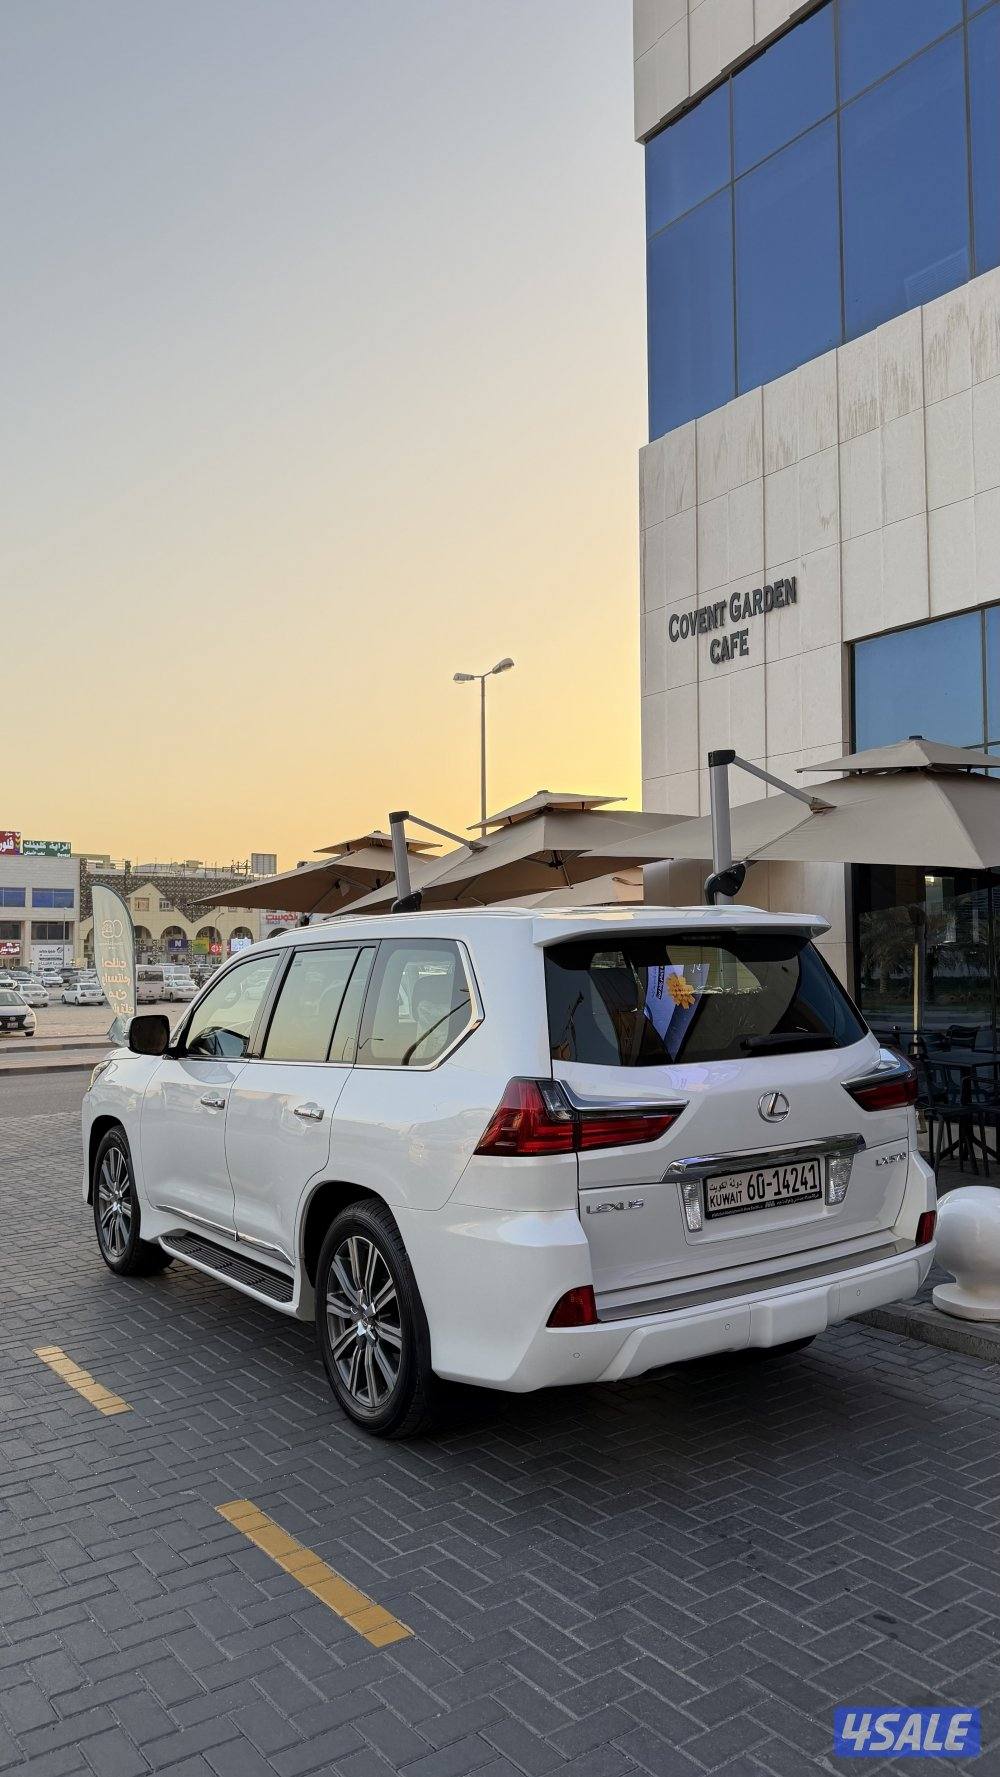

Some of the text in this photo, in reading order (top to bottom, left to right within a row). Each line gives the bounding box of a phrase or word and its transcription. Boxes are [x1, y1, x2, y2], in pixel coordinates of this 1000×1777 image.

[669, 576, 797, 642] COVENT GARDEN
[710, 628, 749, 664] CAFE
[730, 1178, 742, 1189] دولة
[747, 1164, 818, 1201] 60-14241
[586, 1198, 644, 1215] LEXUS
[709, 1190, 743, 1208] KUWAIT
